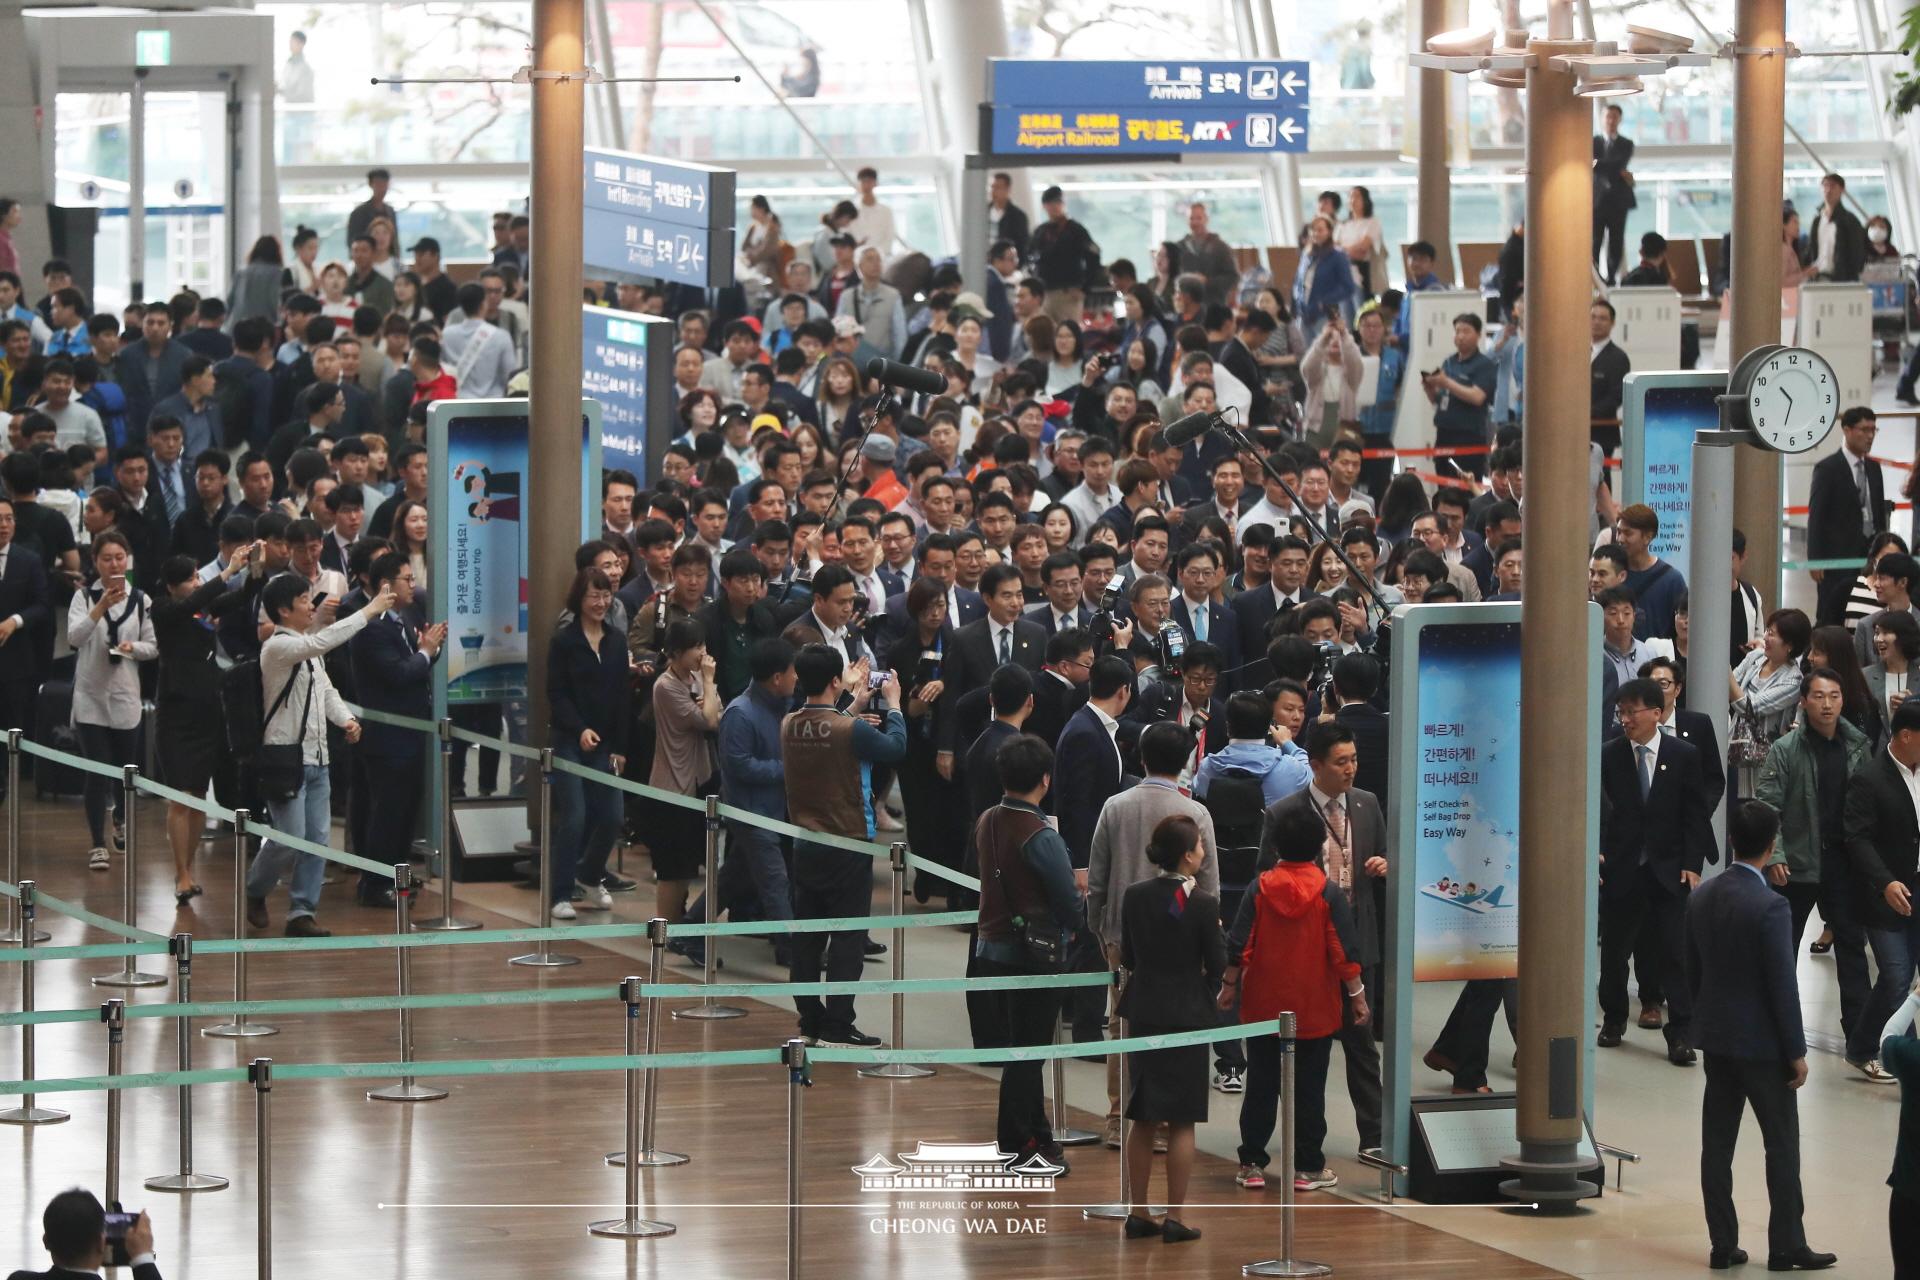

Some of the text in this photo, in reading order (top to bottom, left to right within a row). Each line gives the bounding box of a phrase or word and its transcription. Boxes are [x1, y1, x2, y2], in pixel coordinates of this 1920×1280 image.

[1208, 73, 1241, 94] 도착
[1149, 85, 1203, 100] Arrivals
[1017, 131, 1120, 149] Airport Railroad
[1788, 355, 1798, 365] 12
[1807, 360, 1813, 369] 1
[1770, 361, 1779, 370] 11
[1757, 377, 1767, 387] 10
[1820, 374, 1827, 384] 2
[1754, 397, 1760, 407] 9
[1825, 394, 1831, 404] 3
[1759, 417, 1765, 427] 8
[1819, 415, 1826, 425] 4
[1772, 432, 1778, 442] 7
[1789, 436, 1795, 446] 6
[1807, 431, 1813, 441] 5
[1666, 542, 1682, 553] Way
[457, 523, 469, 615] 즐거운 여행되세요!
[472, 548, 483, 615] Enjoy your trip
[1424, 723, 1464, 738] 빠르게!
[1424, 747, 1475, 763] 간편하게!
[1424, 771, 1479, 787] 떠나세요!!
[1424, 799, 1469, 809] Self Check-in
[1424, 811, 1471, 822] Self Bag Drop
[1424, 827, 1467, 840] Easy Way
